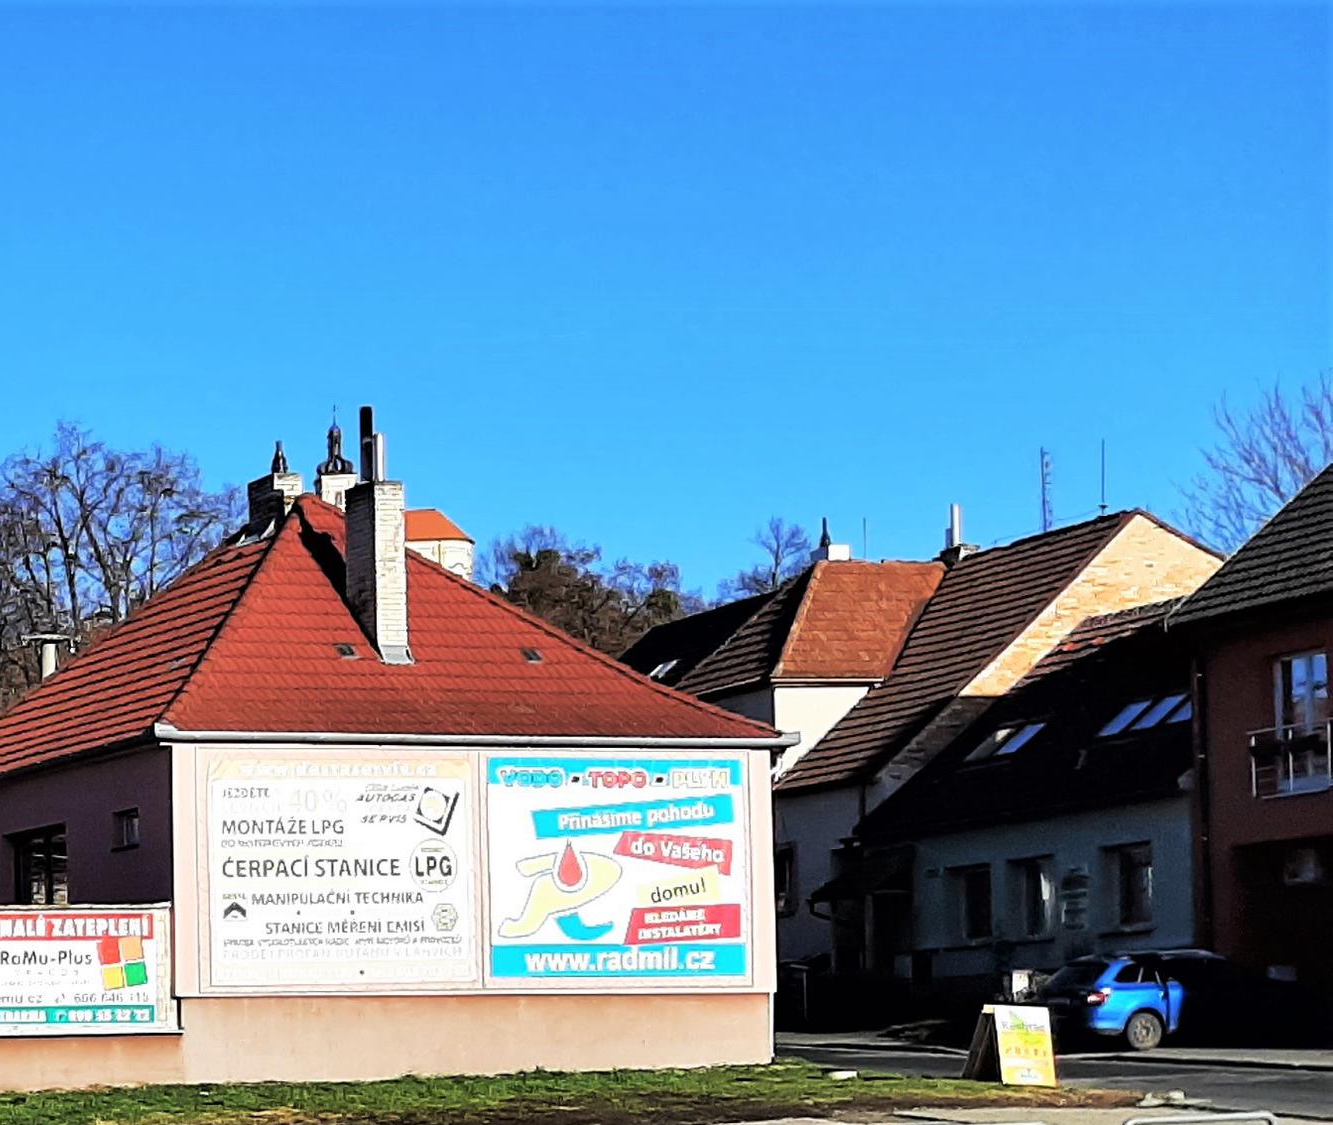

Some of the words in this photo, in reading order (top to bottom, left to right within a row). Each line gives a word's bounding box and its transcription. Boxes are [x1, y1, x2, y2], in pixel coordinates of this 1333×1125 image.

[589, 770, 647, 788] TOPO
[221, 817, 307, 835] MONTÁŽE
[312, 819, 345, 834] LPG
[630, 843, 655, 856] do
[221, 855, 310, 878] ČERPACÍ
[314, 857, 402, 877] STANICE
[415, 855, 453, 877] LPG
[251, 888, 350, 905] MANIPULAČNÍ
[651, 877, 706, 904] domu!
[264, 921, 323, 935] STANICE
[0, 950, 93, 966] RaMu-Plus
[525, 947, 717, 973] www.radmil.cz
